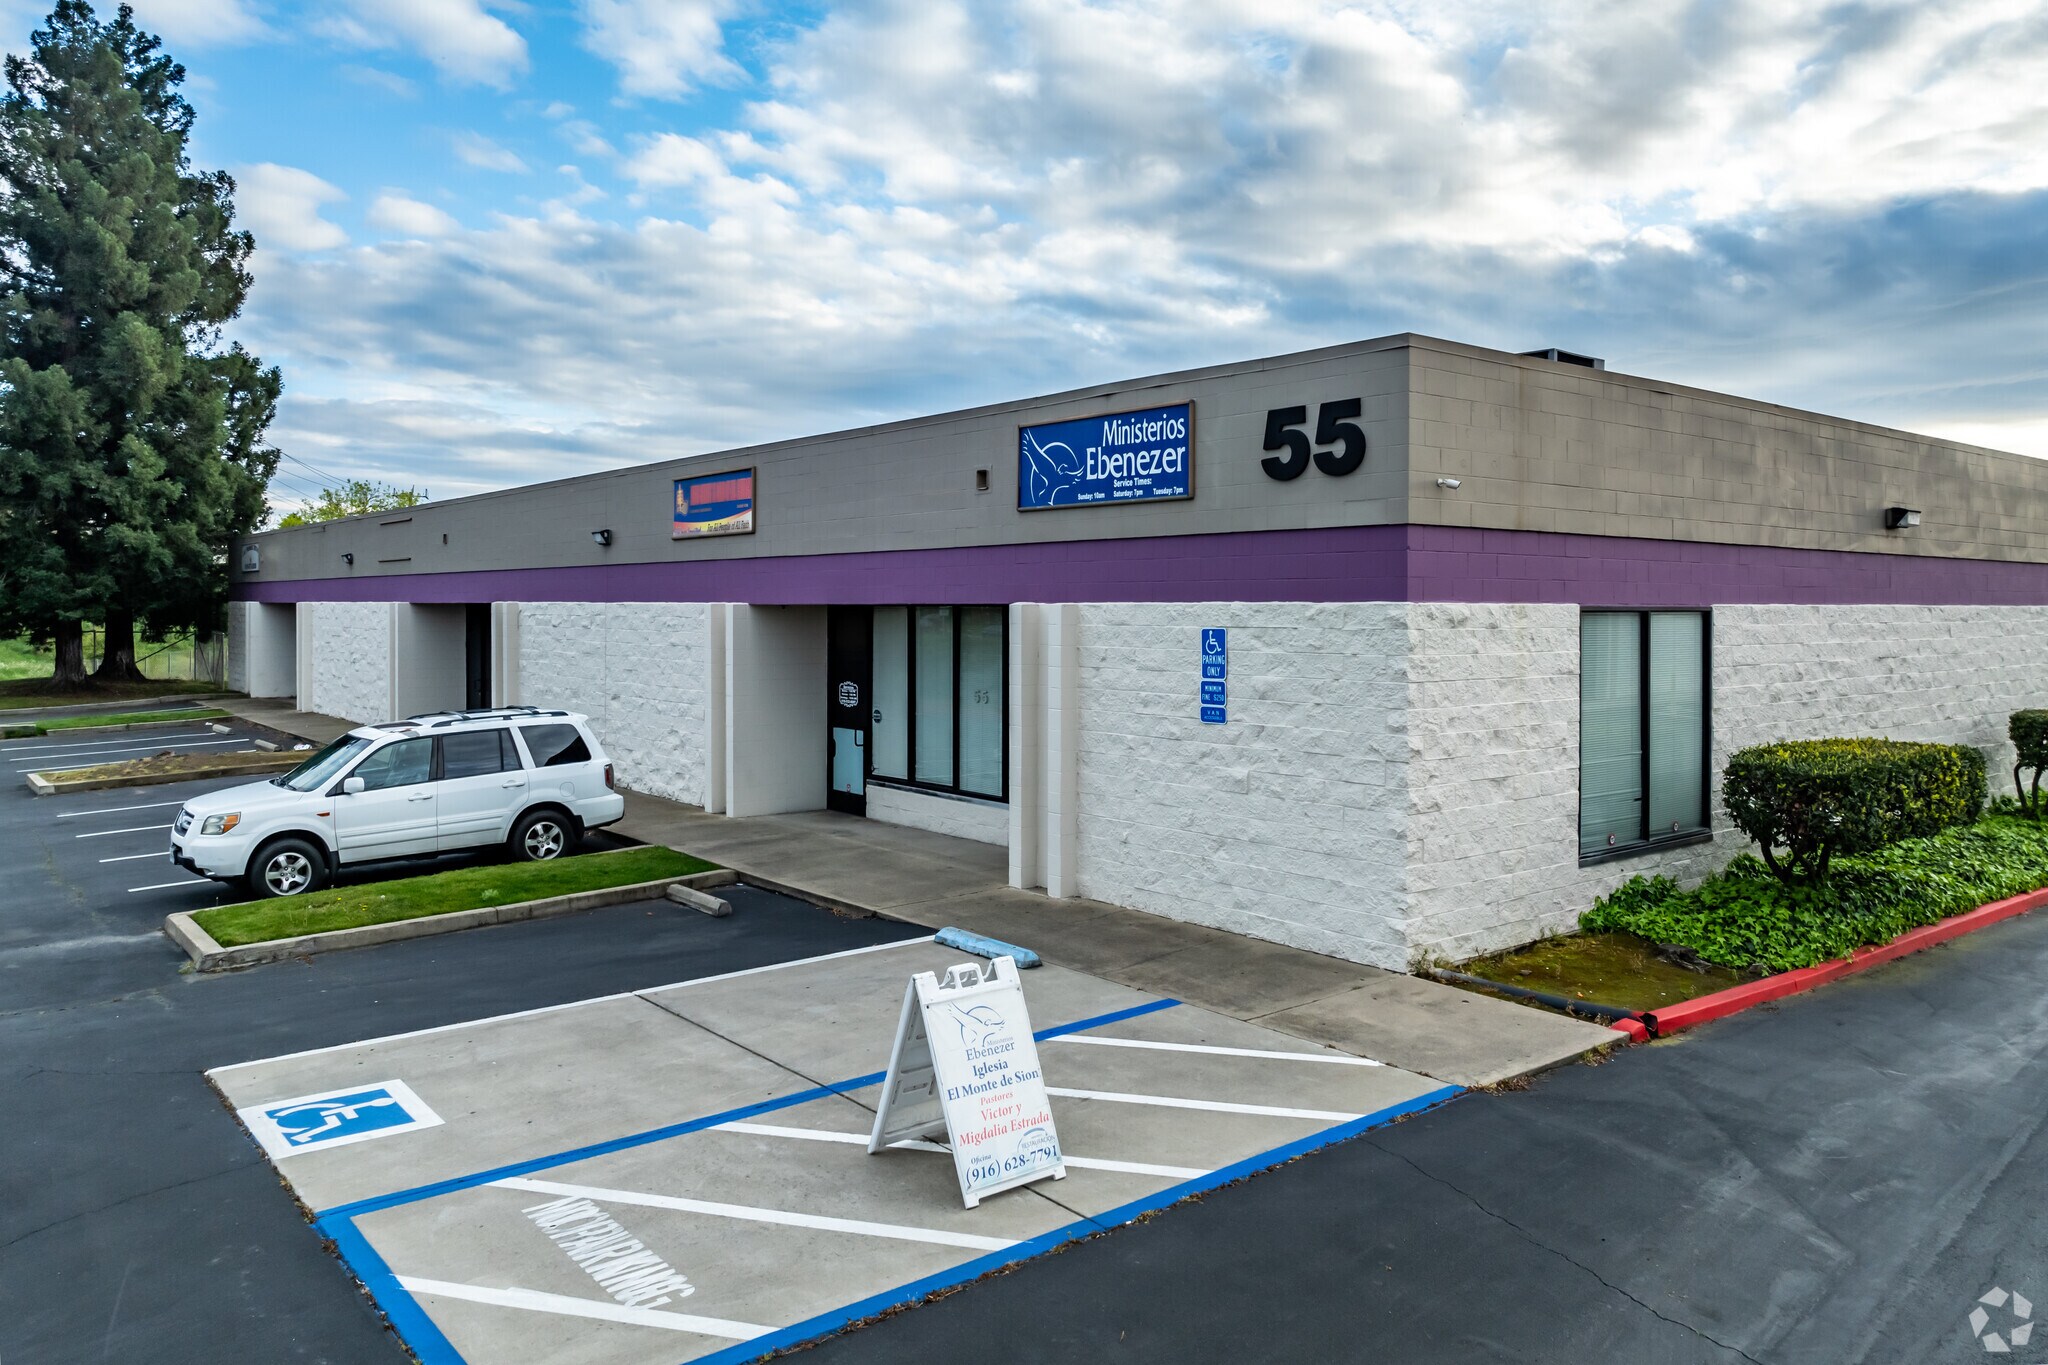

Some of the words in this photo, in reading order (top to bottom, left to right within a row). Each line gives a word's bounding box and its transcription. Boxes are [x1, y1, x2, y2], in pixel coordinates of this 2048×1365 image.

[1102, 413, 1186, 447] Ministerios
[1260, 397, 1367, 481] 55
[1086, 446, 1186, 480] Ebenezer
[1113, 479, 1133, 488] Service
[1133, 477, 1152, 486] Times:
[1153, 487, 1172, 495] Tuesday:
[1173, 486, 1183, 494] 7pm
[1113, 490, 1133, 498] Saturday:
[1133, 489, 1143, 497] 7pm
[1202, 654, 1225, 665] PARKING
[1206, 666, 1220, 676] ONLY
[965, 1042, 1015, 1061] Ebenezer
[972, 1059, 1009, 1079] Iglesia
[947, 1086, 960, 1101] El
[961, 1080, 998, 1097] Monte
[1000, 1074, 1013, 1087] de
[1014, 1070, 1039, 1083] Sion
[980, 1091, 1013, 1106] Pastores
[981, 1105, 1013, 1122] Victor
[1015, 1103, 1022, 1117] y
[959, 1124, 1008, 1147] Migdalia
[1010, 1111, 1050, 1132] Estrada
[966, 1159, 1001, 1187] (916)
[1004, 1144, 1057, 1172] 628-7791
[970, 1154, 992, 1166] Oficina
